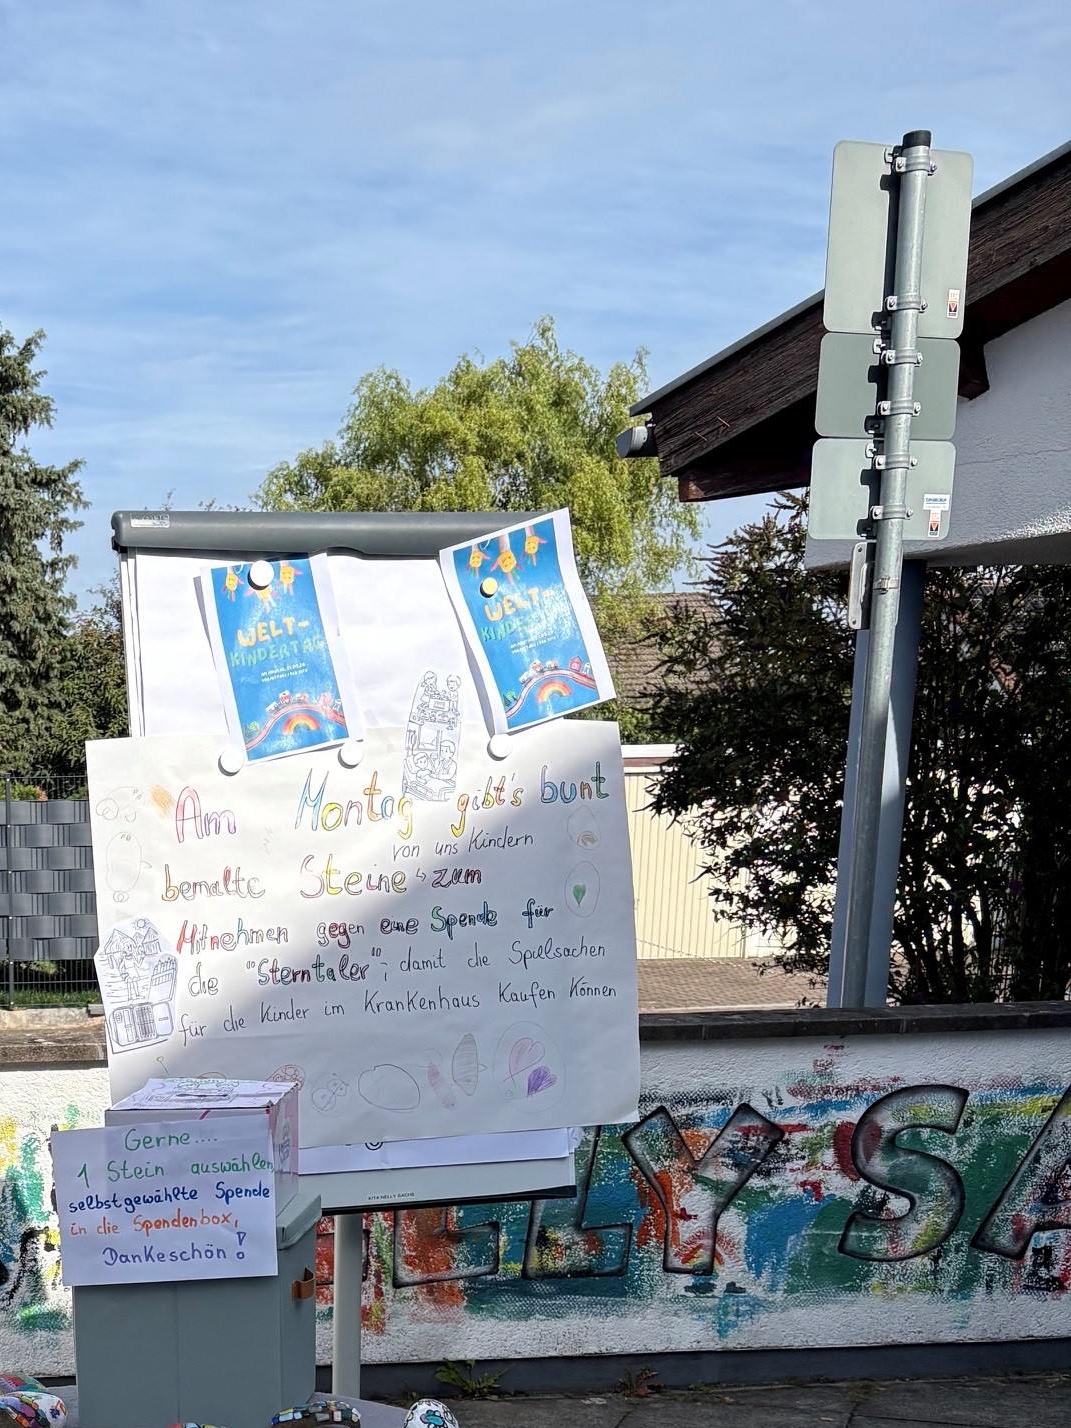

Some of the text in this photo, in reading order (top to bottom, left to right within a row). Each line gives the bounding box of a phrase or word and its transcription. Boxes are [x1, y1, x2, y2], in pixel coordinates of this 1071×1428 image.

[236, 617, 309, 647] WELT-
[176, 761, 610, 843] Am Montag gibt's bunt
[392, 826, 534, 862] von uns Kindern
[299, 854, 408, 899] Steine
[176, 898, 555, 955] Mitnehmen gegen eine Spende für
[187, 961, 219, 997] die
[399, 946, 448, 973] damit
[467, 942, 491, 969] die
[508, 936, 606, 970] Spielsachen
[178, 1013, 207, 1047] für
[223, 1004, 247, 1033] die
[324, 1001, 345, 1016] im
[77, 1163, 90, 1189] 1
[107, 1160, 165, 1183] Stein
[68, 1180, 271, 1214] selbstgewählte Spende
[70, 1224, 87, 1237] in
[96, 1217, 120, 1236] die
